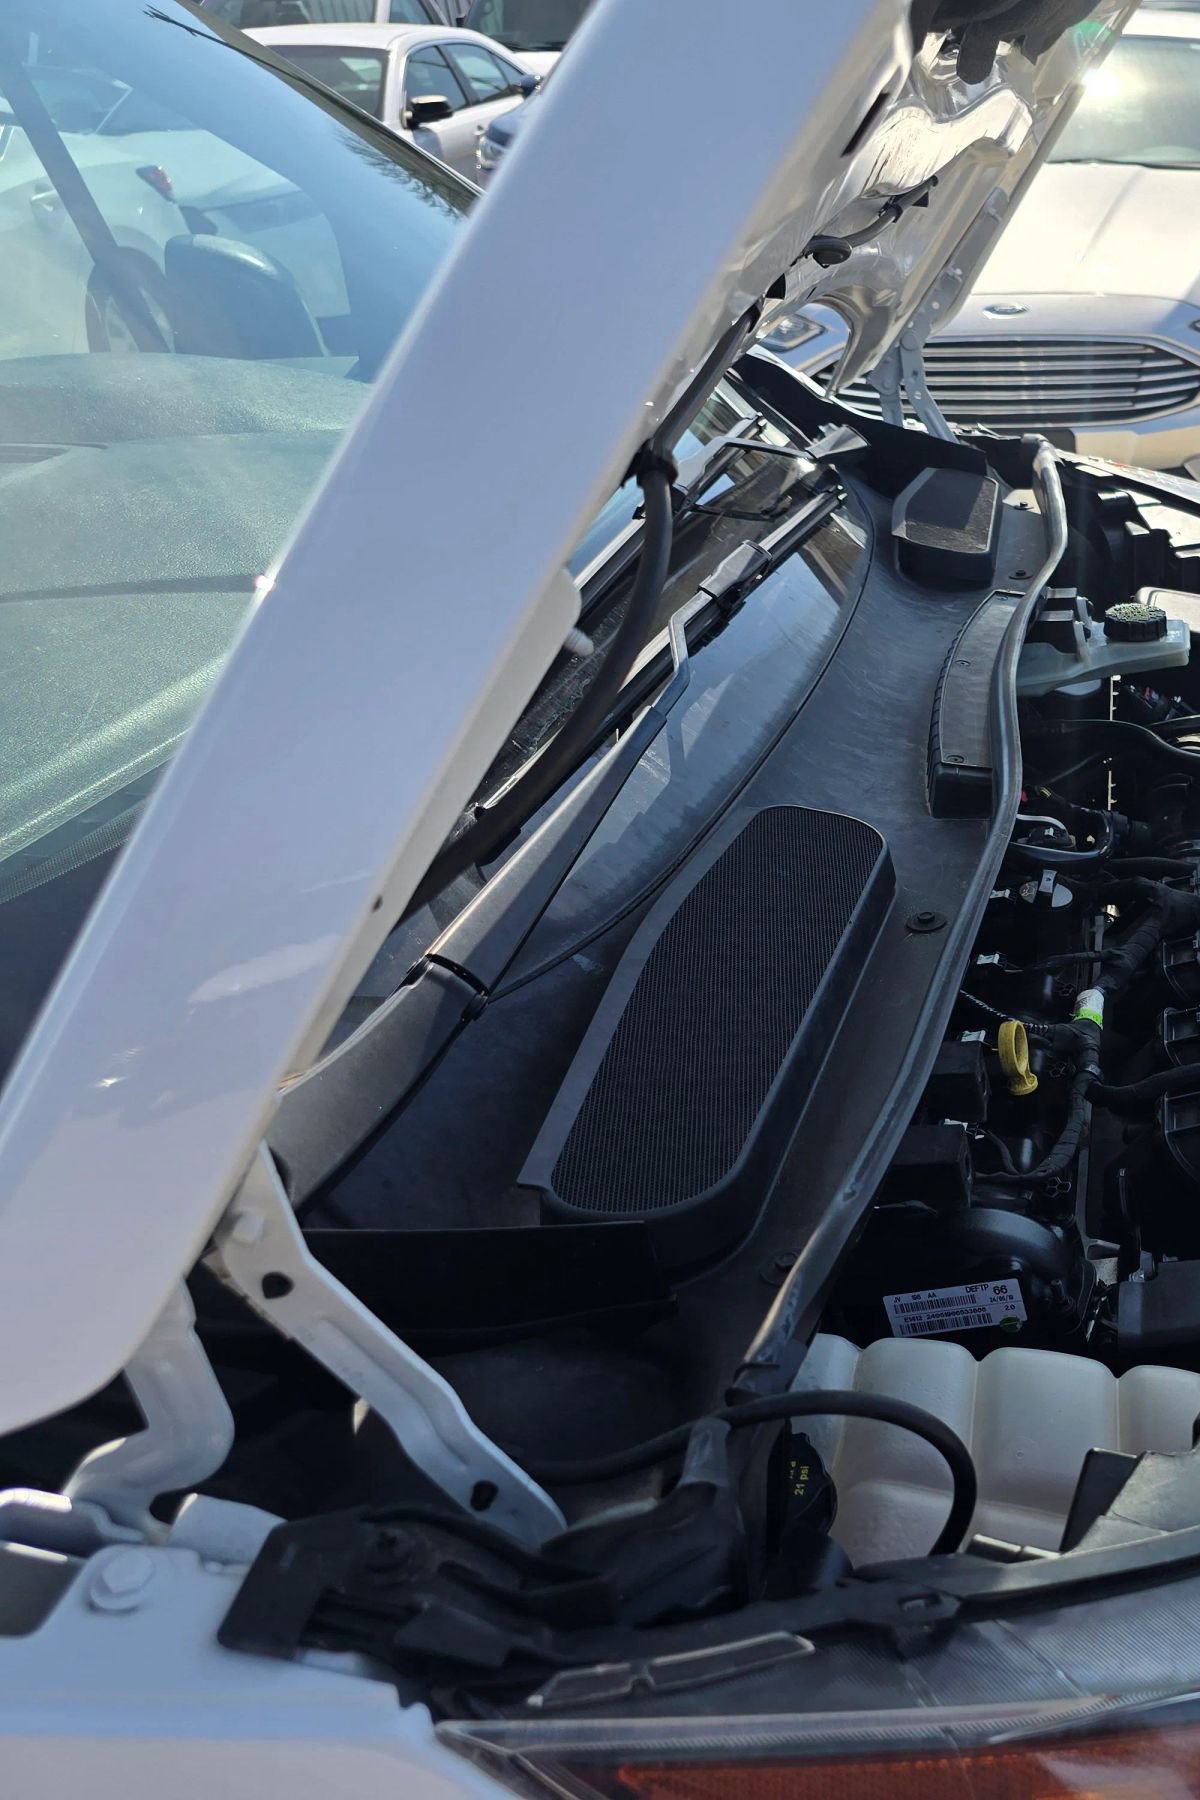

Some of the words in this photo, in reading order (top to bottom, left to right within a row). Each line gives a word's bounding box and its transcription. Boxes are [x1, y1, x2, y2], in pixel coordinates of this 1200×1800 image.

[993, 1285, 1008, 1295] 66
[794, 1484, 805, 1495] 21
[800, 1466, 809, 1480] psi
